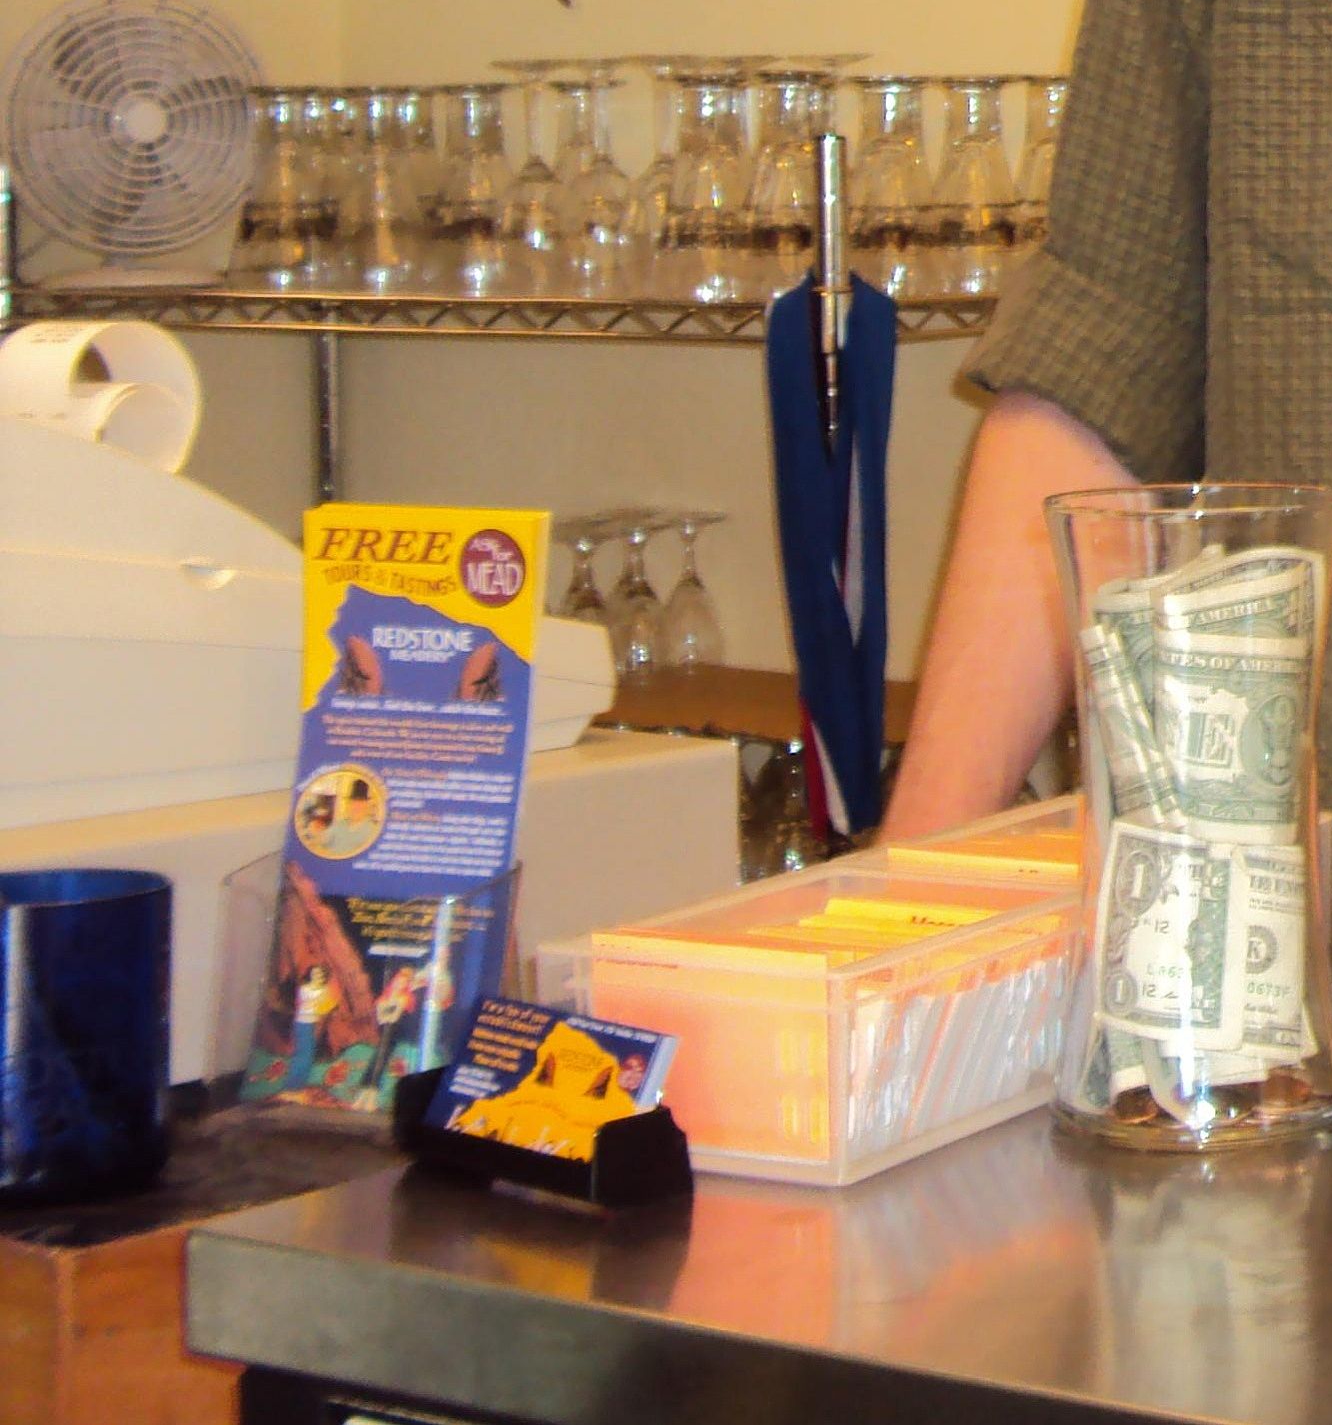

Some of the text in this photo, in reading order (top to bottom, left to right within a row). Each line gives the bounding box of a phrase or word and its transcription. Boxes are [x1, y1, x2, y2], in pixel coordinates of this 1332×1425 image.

[313, 527, 453, 565] FREE
[466, 561, 522, 597] MEAD
[371, 626, 474, 653] REDSTONE
